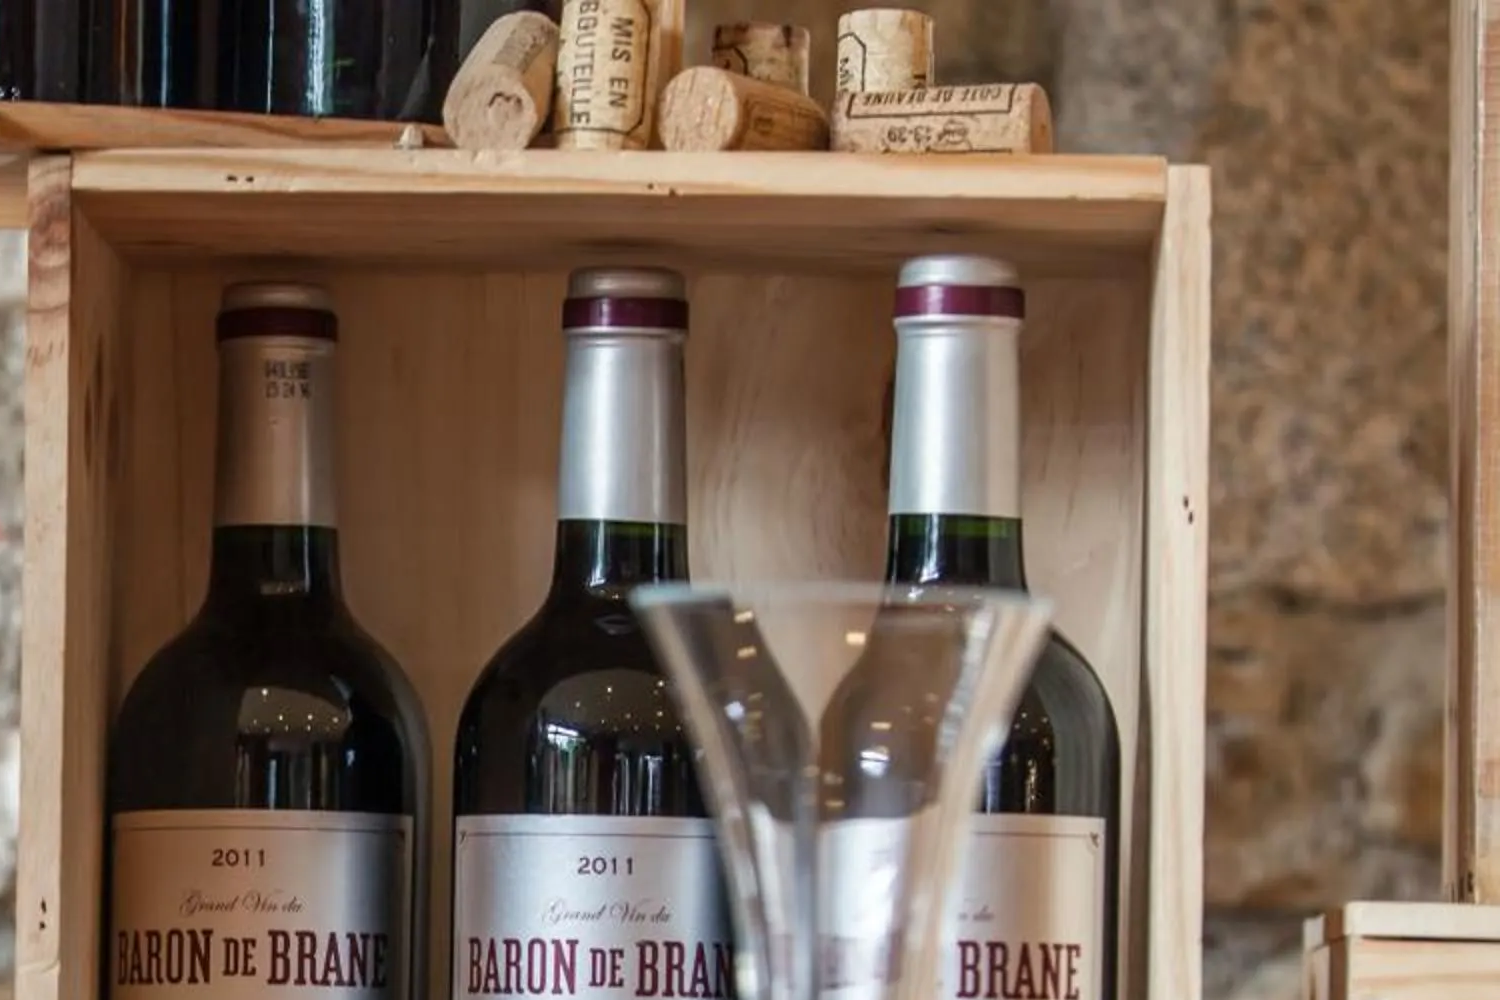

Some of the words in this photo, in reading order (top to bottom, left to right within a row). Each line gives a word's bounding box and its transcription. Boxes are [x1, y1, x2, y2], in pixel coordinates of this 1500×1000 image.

[610, 17, 634, 62] MIS
[608, 77, 629, 109] EN
[211, 849, 266, 868] 2011
[577, 856, 635, 875] 2011
[117, 928, 214, 986] BARON
[222, 937, 257, 978] DE
[267, 929, 389, 989] BRANE
[467, 936, 580, 995] BARON
[589, 947, 625, 988] DE
[634, 939, 735, 999] BRAN
